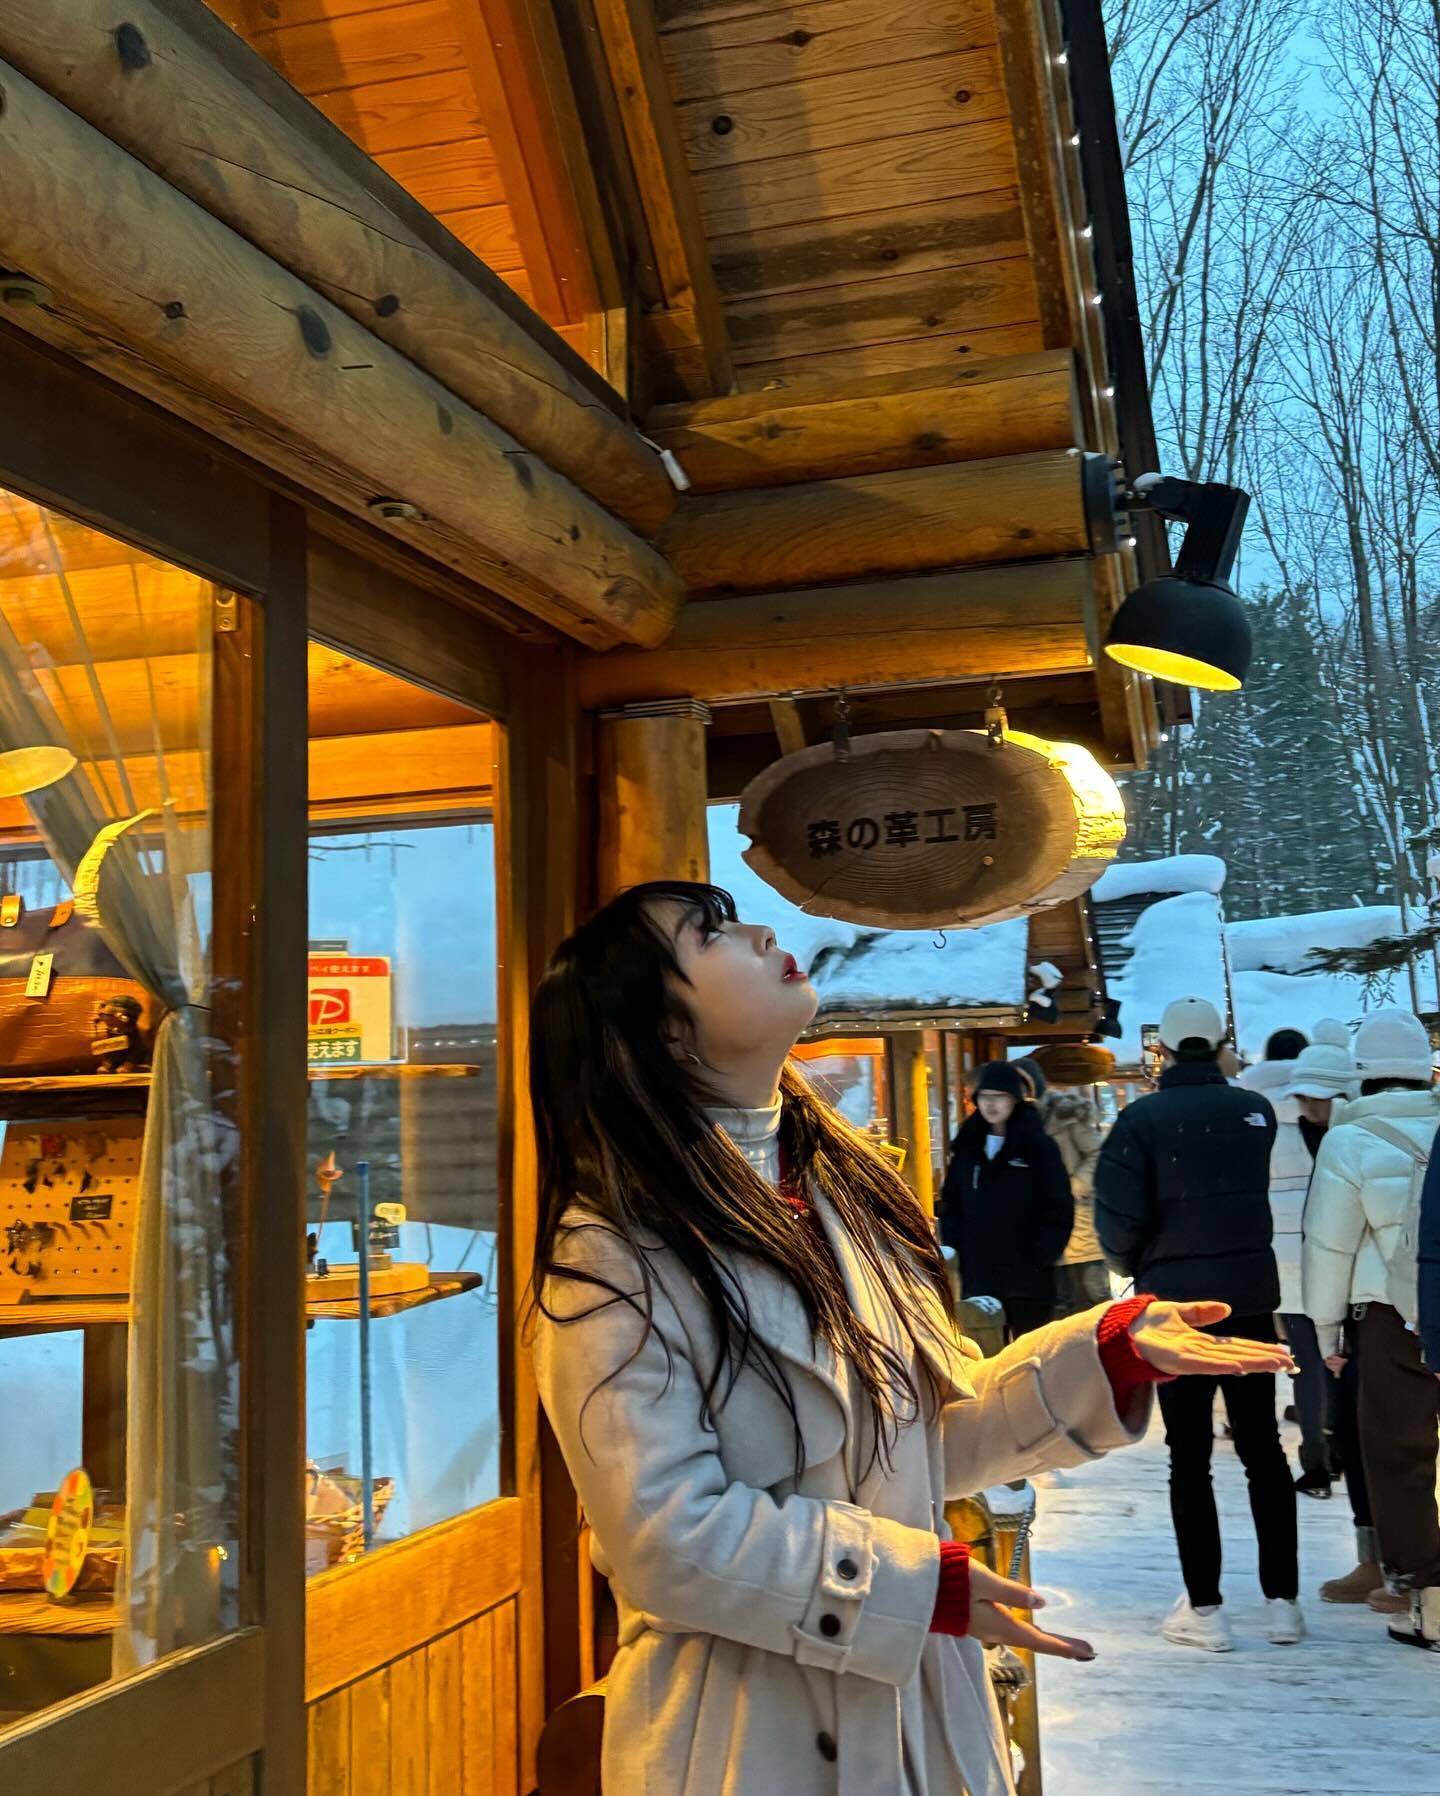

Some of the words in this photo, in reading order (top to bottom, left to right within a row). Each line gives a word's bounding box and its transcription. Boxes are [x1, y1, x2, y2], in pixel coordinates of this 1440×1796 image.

[807, 802, 998, 859] 森の革工房
